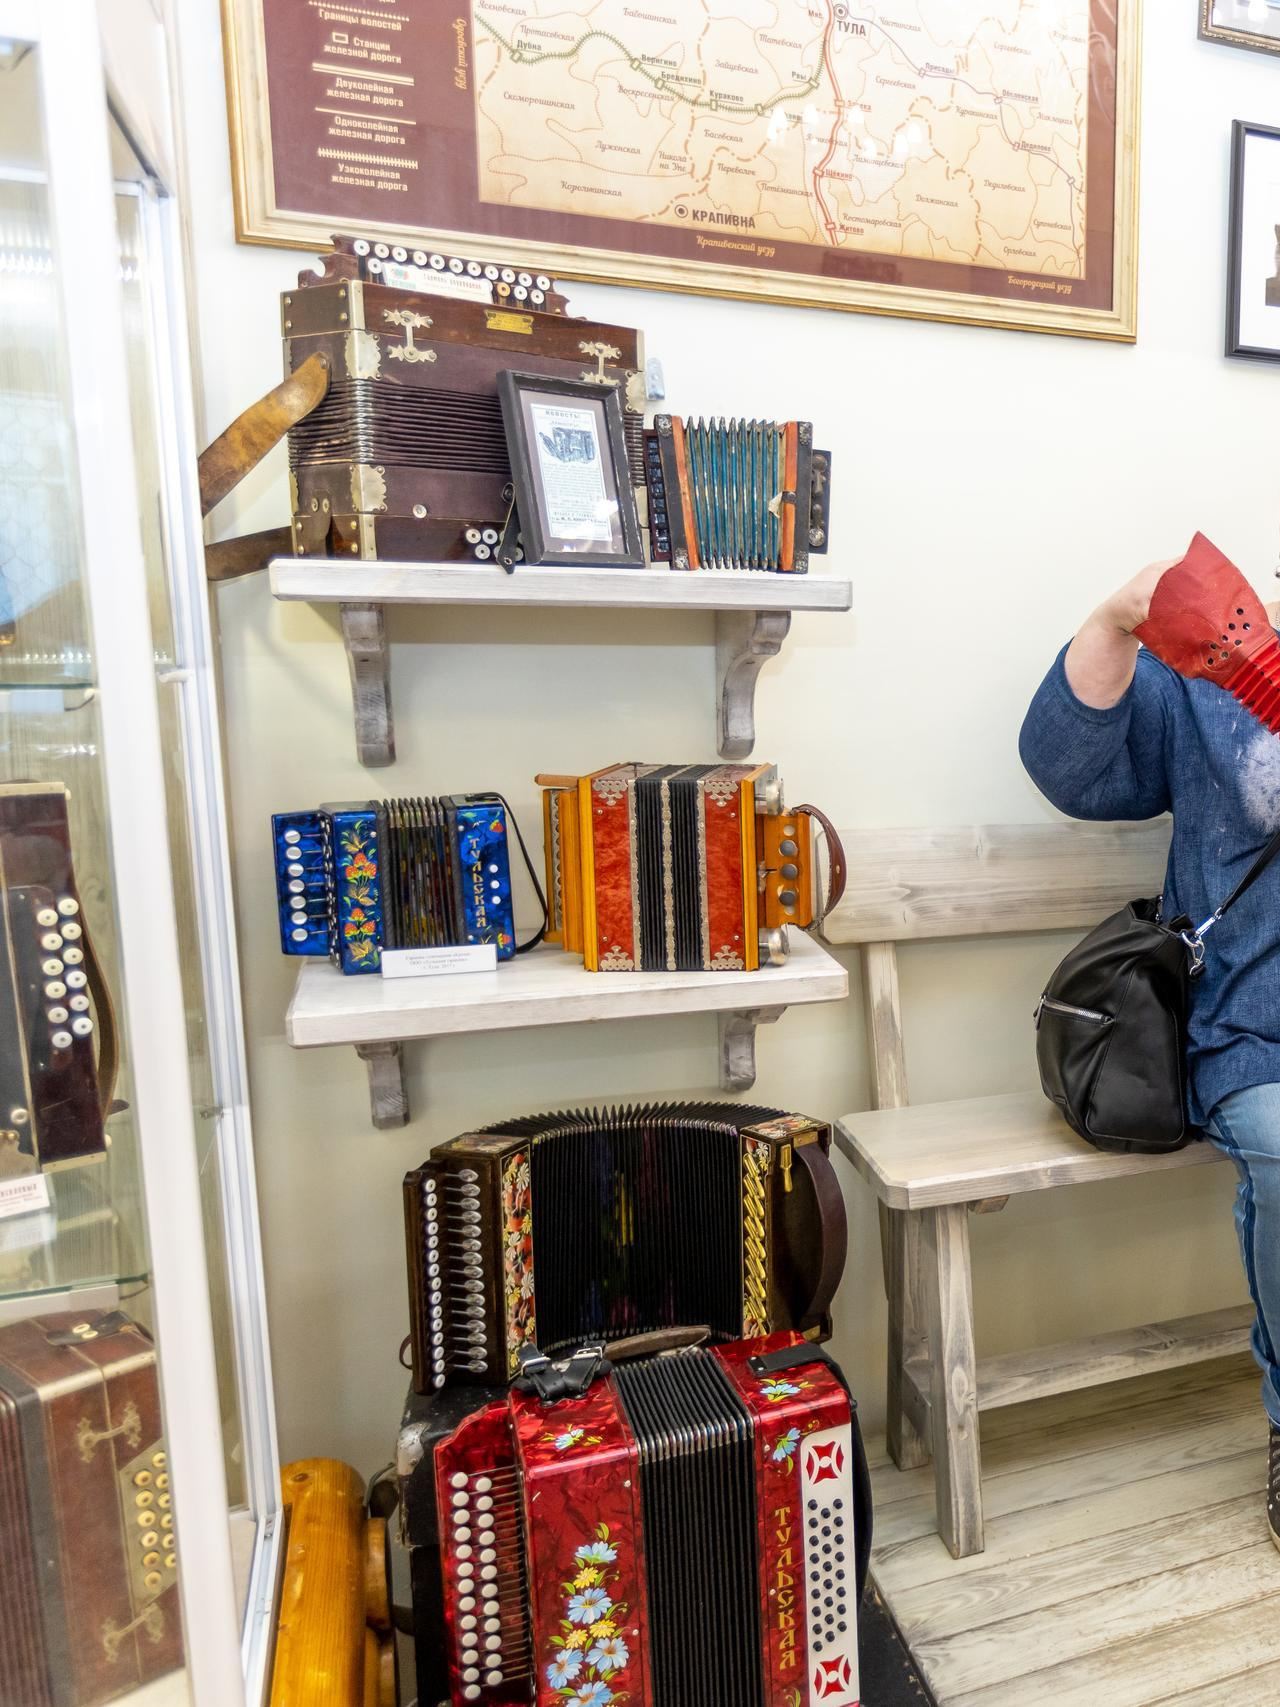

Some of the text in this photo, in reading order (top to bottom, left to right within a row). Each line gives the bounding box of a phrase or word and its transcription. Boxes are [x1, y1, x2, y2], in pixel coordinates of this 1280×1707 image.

[319, 8, 402, 31] Границы волостей
[837, 20, 867, 36] ТУЛА
[453, 18, 468, 67] Одоевский
[520, 24, 575, 43] Протасовская
[354, 37, 391, 52] Станции
[517, 39, 543, 52] Дубна
[324, 44, 402, 65] железной дороги
[641, 54, 678, 68] Веригино
[715, 59, 760, 75] Зайцевская
[327, 88, 404, 108] железная дорога
[503, 91, 576, 111] Скоморошинская
[617, 83, 675, 102] Воскресенская
[709, 89, 744, 103] Кураково
[334, 116, 400, 134] Одноколейная
[328, 126, 407, 146] железная дорога
[704, 129, 745, 143] Басовская
[658, 150, 688, 163] Никола
[337, 163, 401, 180] Узкоколейная
[659, 161, 670, 171] на
[331, 174, 409, 193] железная дорога
[692, 209, 756, 229] КРАПИВНА
[843, 212, 903, 229] Костомаровская
[839, 223, 866, 235] Житово
[696, 235, 776, 259] Крапивенский уезд
[1056, 283, 1074, 295] уезд
[469, 838, 487, 928] ТУЛЬСКАЯ
[774, 1506, 797, 1672] ТУЛЬСКАЯ
